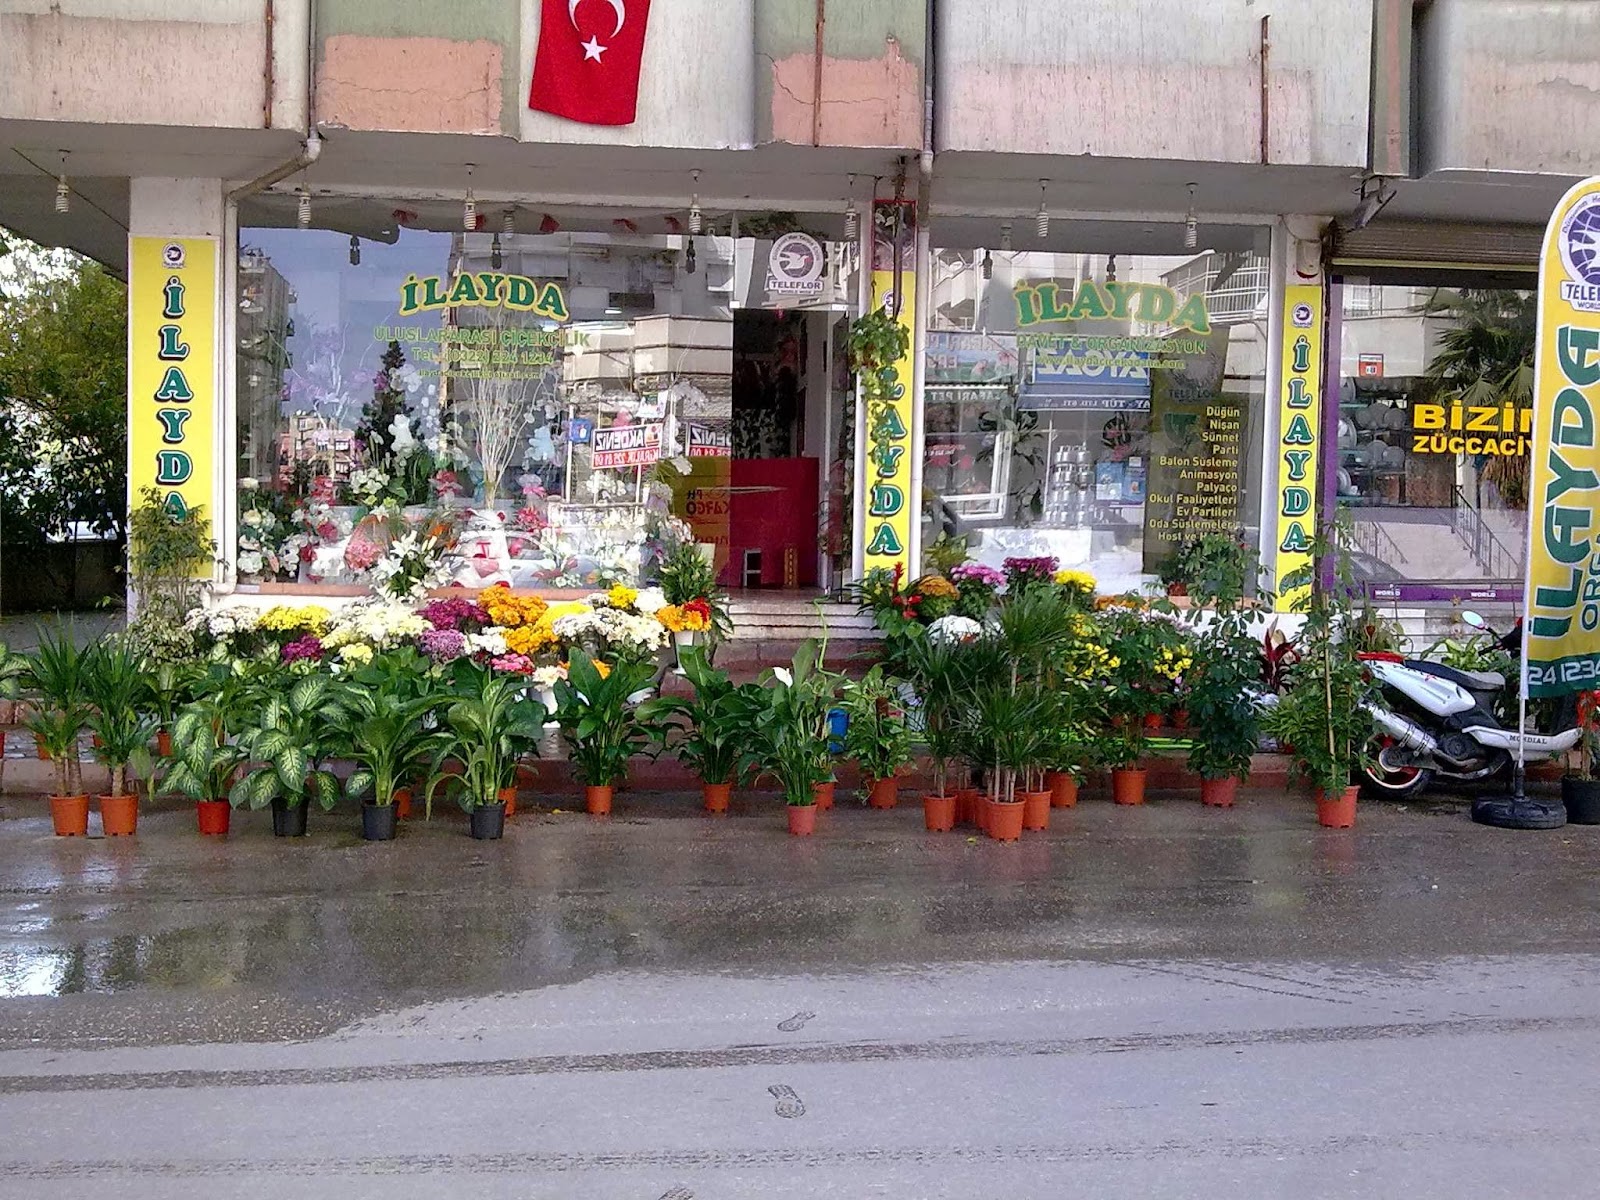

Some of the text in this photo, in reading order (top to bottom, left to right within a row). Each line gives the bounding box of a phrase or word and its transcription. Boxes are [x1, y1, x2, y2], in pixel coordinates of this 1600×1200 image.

[771, 281, 820, 289] TELEFLOR
[399, 270, 570, 321] İLAYDA
[1566, 283, 1600, 301] TELE
[1013, 279, 1211, 335] İLAYDA
[373, 326, 496, 345] ULUSLARARASI
[1016, 334, 1066, 350] DAVET
[1070, 337, 1081, 350] &
[154, 274, 194, 526] İLAYDA
[1206, 406, 1240, 419] Düğün
[1209, 419, 1240, 431] Nişan
[1202, 431, 1240, 443] Sünnet
[1212, 444, 1239, 455] Parti
[1280, 335, 1314, 553] İLAYDA
[1159, 456, 1190, 467] Balon
[1180, 469, 1238, 482] Animasyon
[1196, 482, 1238, 494] Palyaço
[1149, 493, 1237, 506] Okul Faaliyetleri
[1176, 506, 1237, 517] Ev Partileri
[1149, 519, 1169, 529] Oda
[1158, 532, 1182, 541] Host
[1185, 533, 1197, 541] ve
